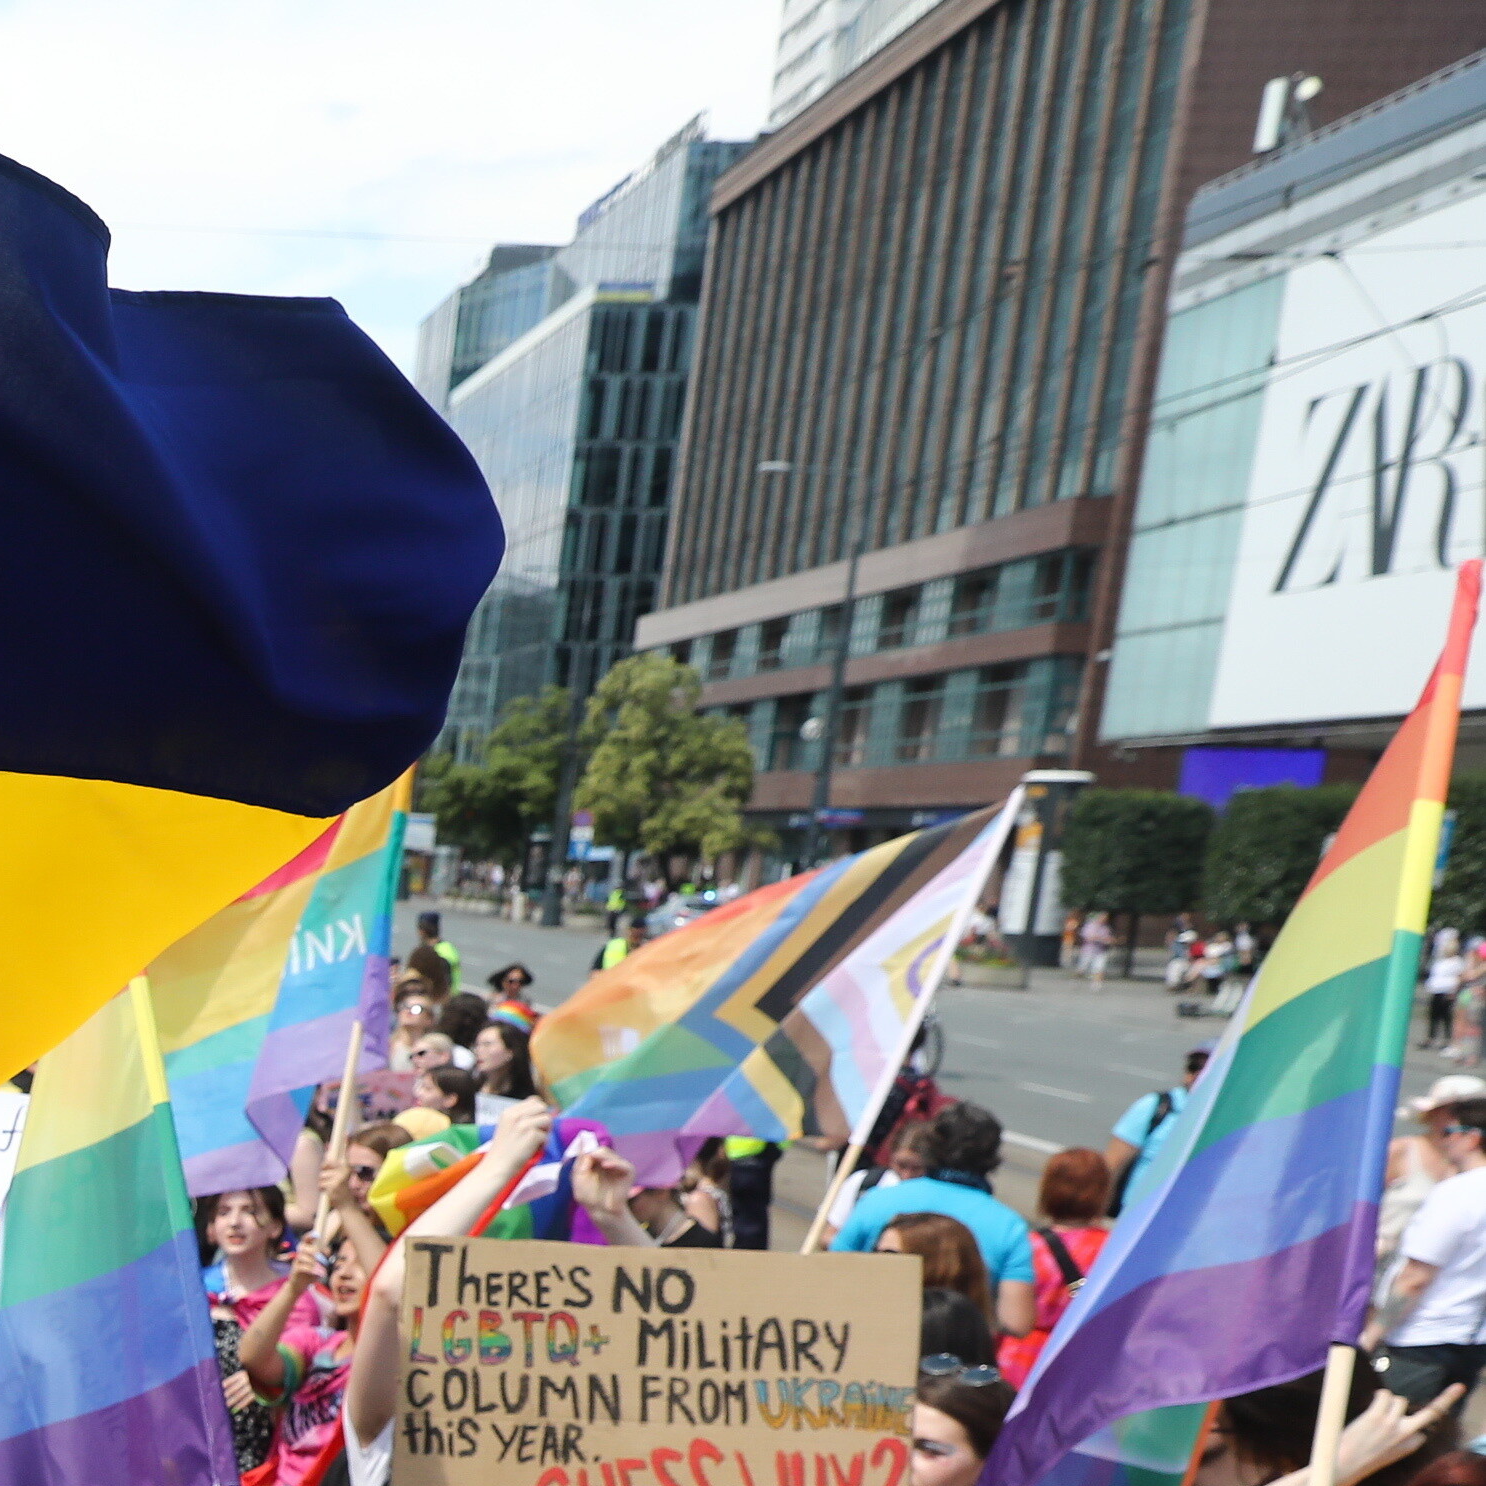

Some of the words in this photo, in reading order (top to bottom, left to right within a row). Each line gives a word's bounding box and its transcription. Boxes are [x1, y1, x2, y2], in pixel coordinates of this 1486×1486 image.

[1271, 355, 1486, 594] ZAR
[612, 1265, 696, 1314] NO
[409, 1306, 610, 1367] LGBTQ+
[406, 1369, 621, 1426] COLUMN
[640, 1375, 749, 1426] FROM
[491, 1421, 601, 1467] YEAR.
